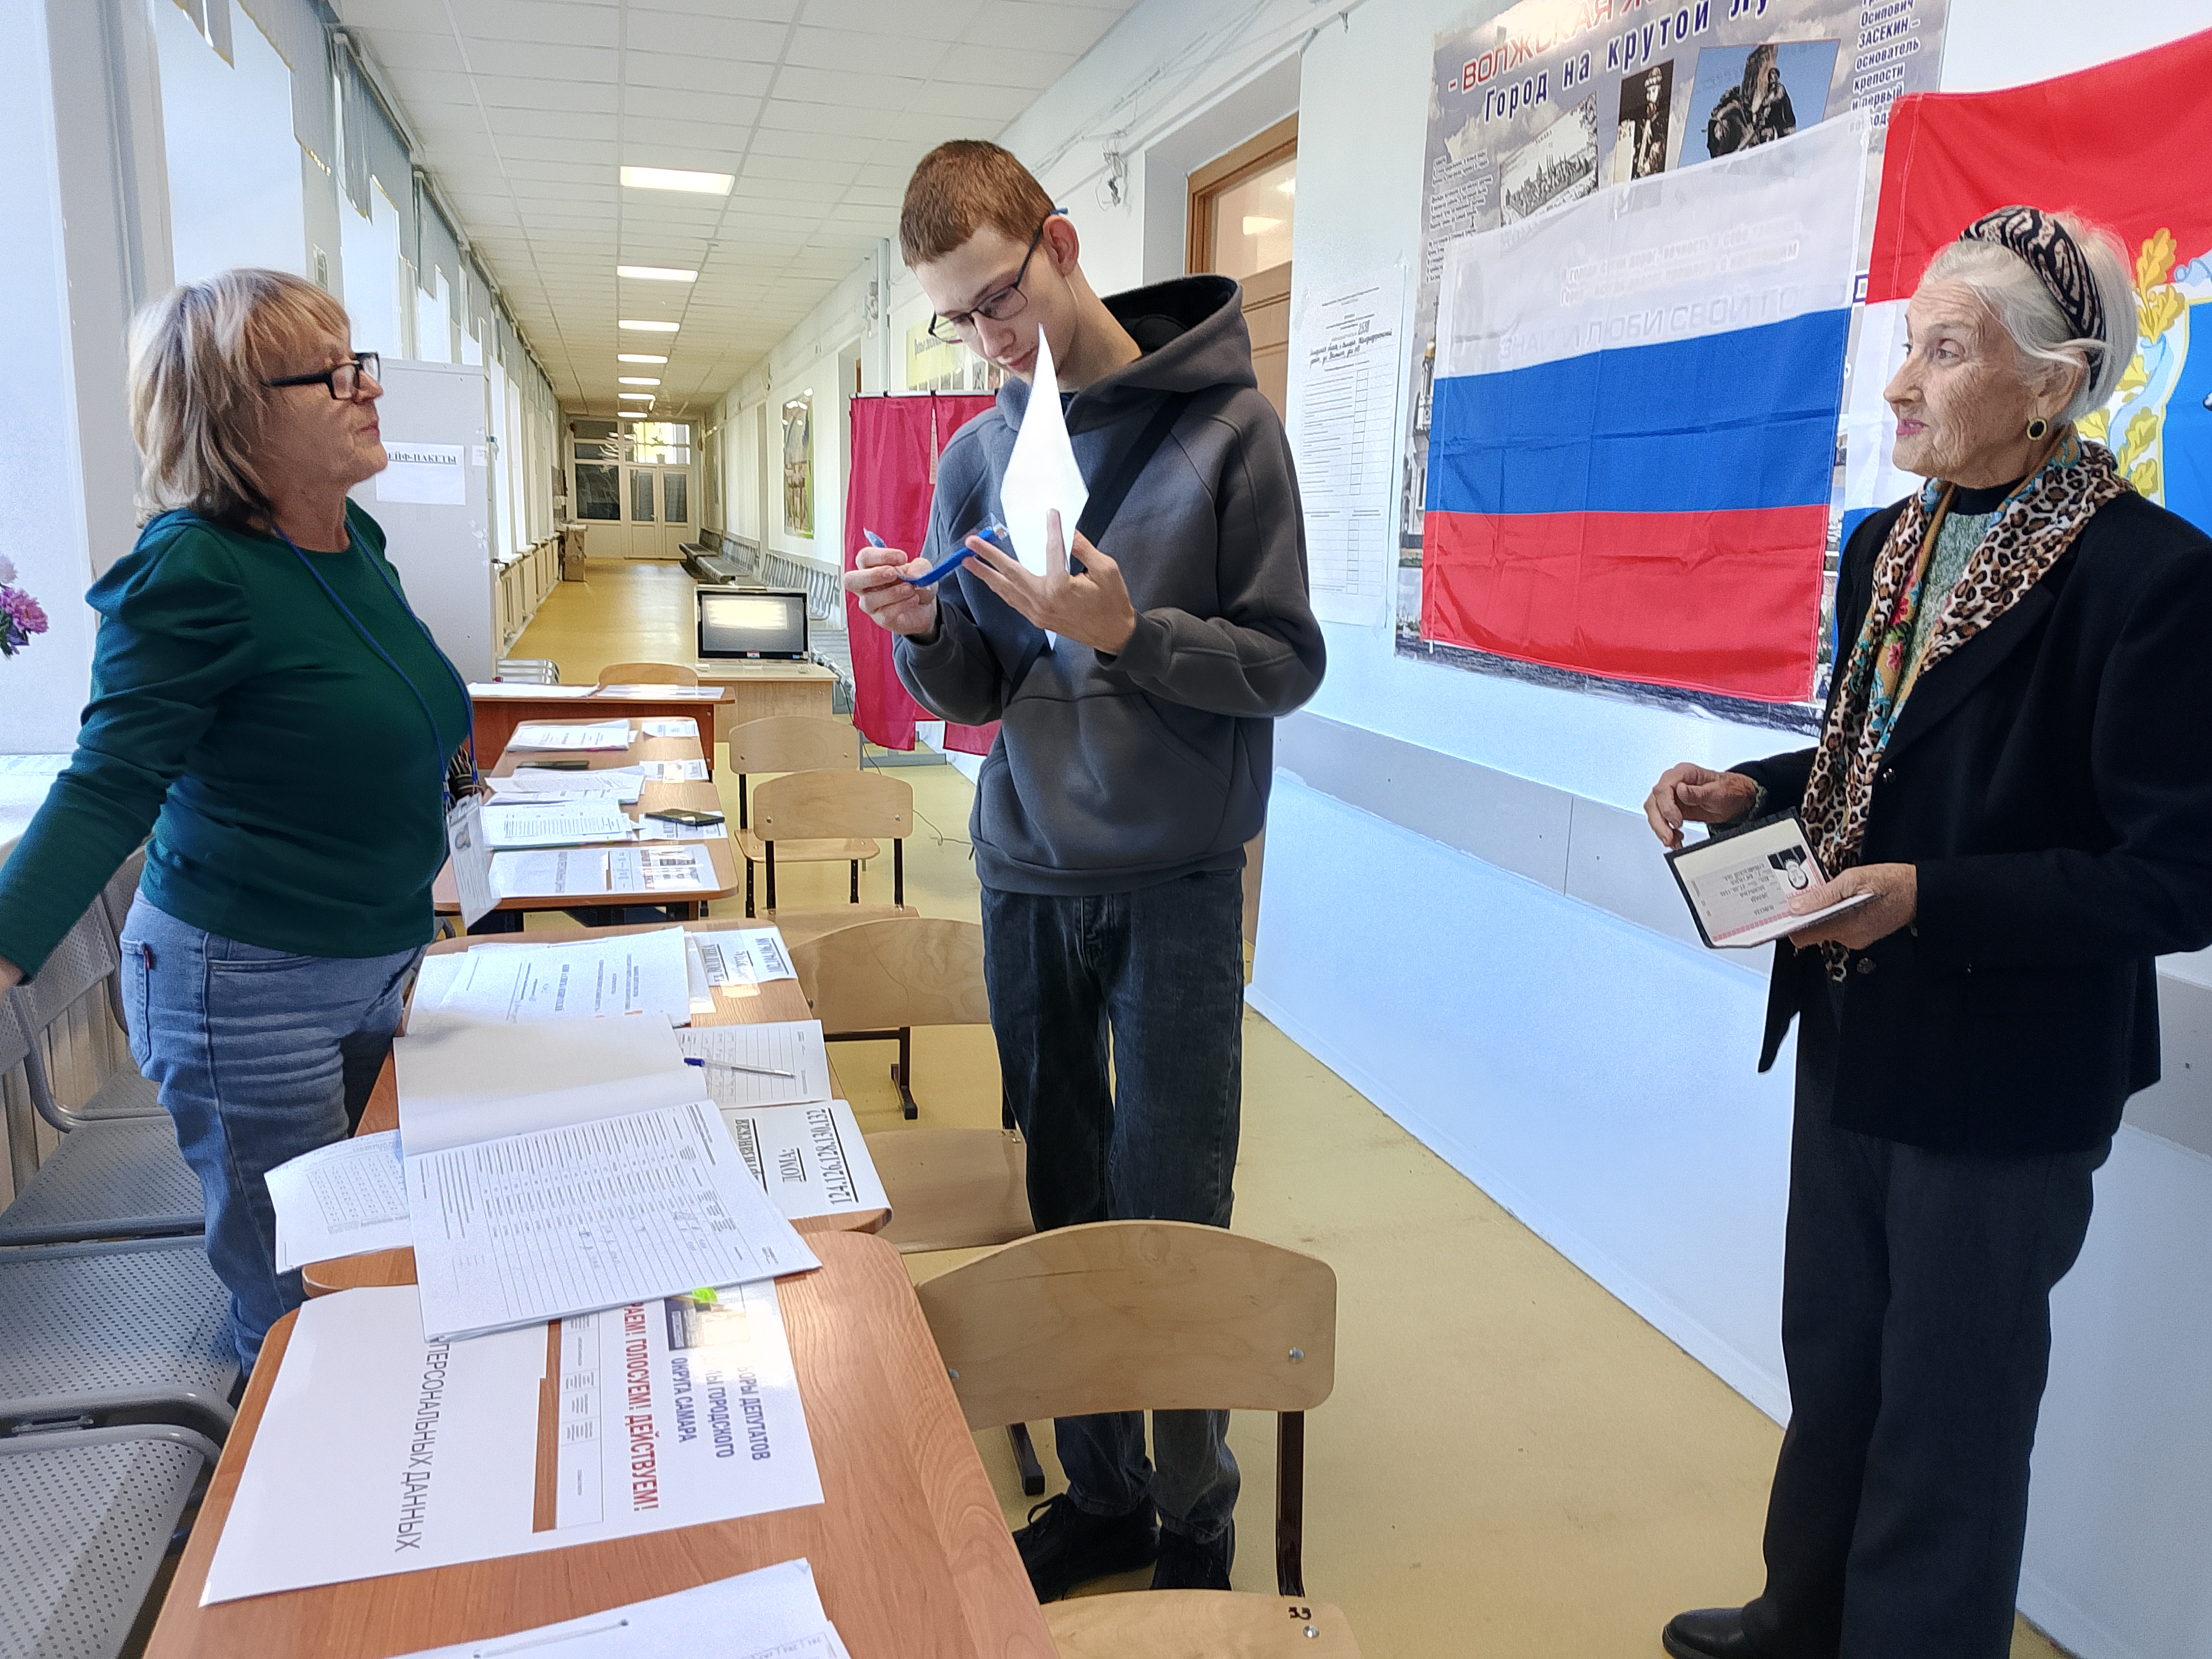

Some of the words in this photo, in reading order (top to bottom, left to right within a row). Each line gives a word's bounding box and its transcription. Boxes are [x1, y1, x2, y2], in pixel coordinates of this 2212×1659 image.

[1856, 39, 1919, 70] основатель
[1858, 17, 1908, 49] ЗАСЕКИН
[1485, 73, 1548, 120] Город
[1563, 53, 1589, 87] на
[1854, 65, 1904, 92] крепости
[1862, 84, 1903, 109] первый
[388, 450, 456, 463] ЕЙФ-ПАКЕТЫ
[625, 1338, 652, 1411] ГОЛОСУЕМ!
[671, 1357, 692, 1395] ОКРУГА
[408, 1343, 450, 1469] ПЕРСОНАЛЬНЫХ
[675, 1396, 697, 1444] САМАРА
[707, 1386, 736, 1459] ГОРОДСКОГО
[739, 1398, 771, 1461] ДЕПУТАТОВ
[625, 1414, 660, 1512] ДЕЙСТВУЕМ!
[394, 1471, 431, 1553] ДАННЫХ
